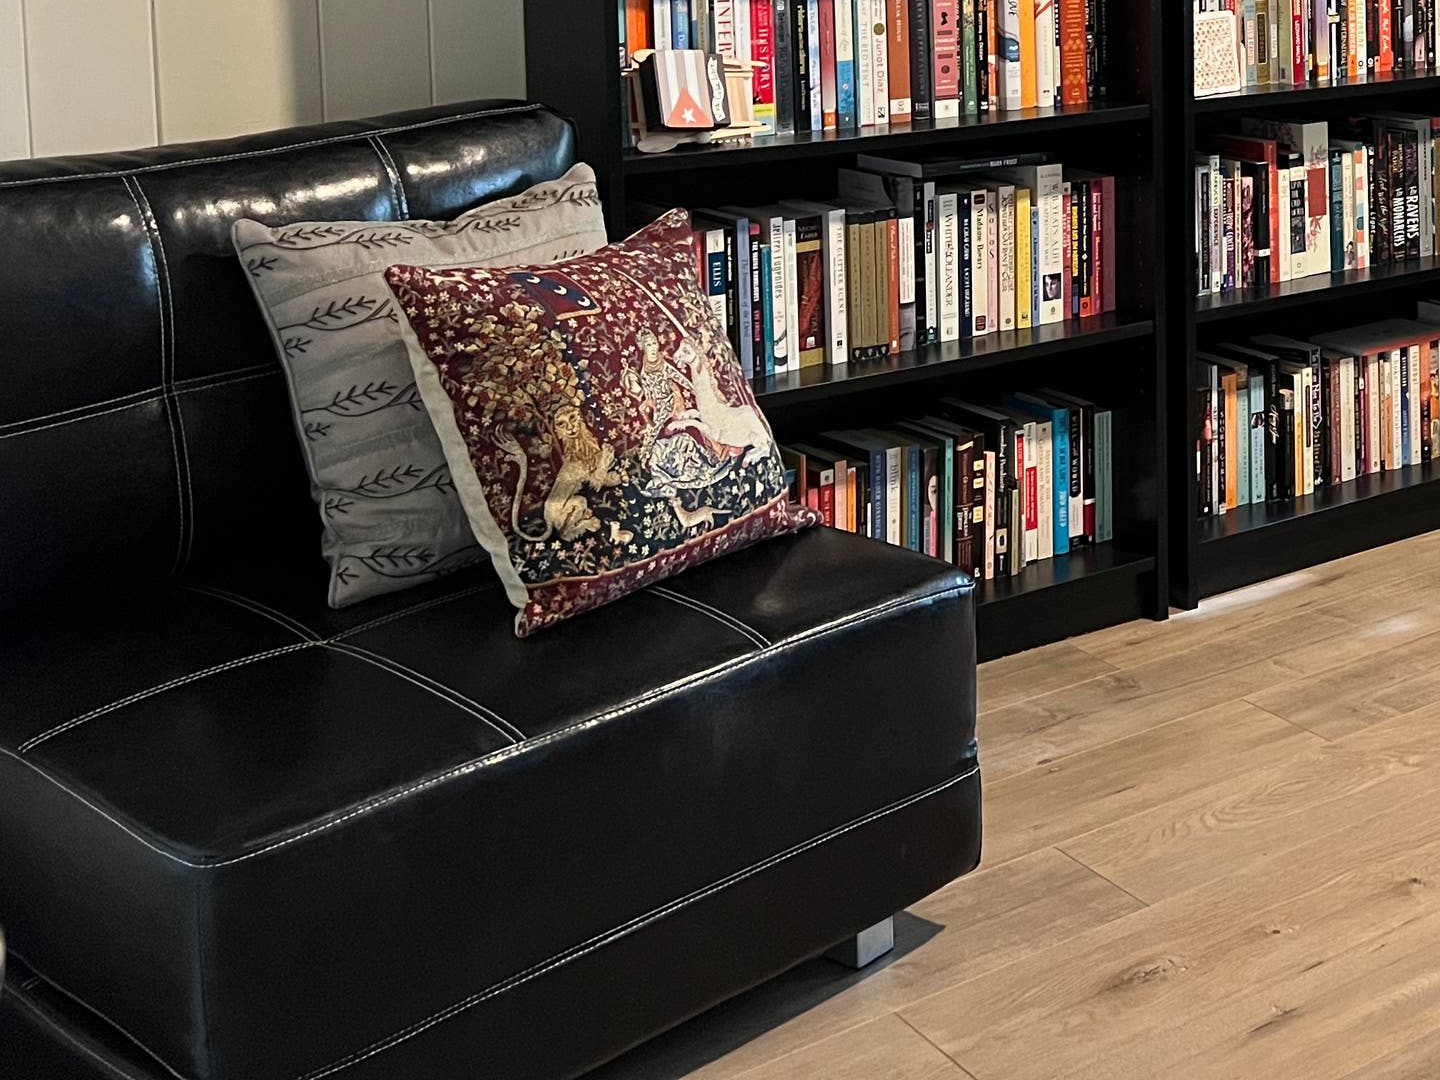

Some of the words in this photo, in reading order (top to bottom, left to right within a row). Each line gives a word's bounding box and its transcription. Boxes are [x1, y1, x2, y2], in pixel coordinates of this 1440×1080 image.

[875, 37, 884, 68] Junot
[1349, 22, 1357, 55] BROKEN
[944, 213, 954, 245] WHITE
[976, 209, 984, 241] Madame
[1212, 207, 1220, 246] EXPERIENCE
[1393, 196, 1405, 247] MONARCHS
[1406, 195, 1420, 239] RAVENS
[976, 245, 984, 270] Bovary
[712, 261, 722, 287] ELLIS
[773, 256, 783, 299] Eugenides
[944, 255, 955, 307] OLEANDER
[889, 463, 900, 493] blink
